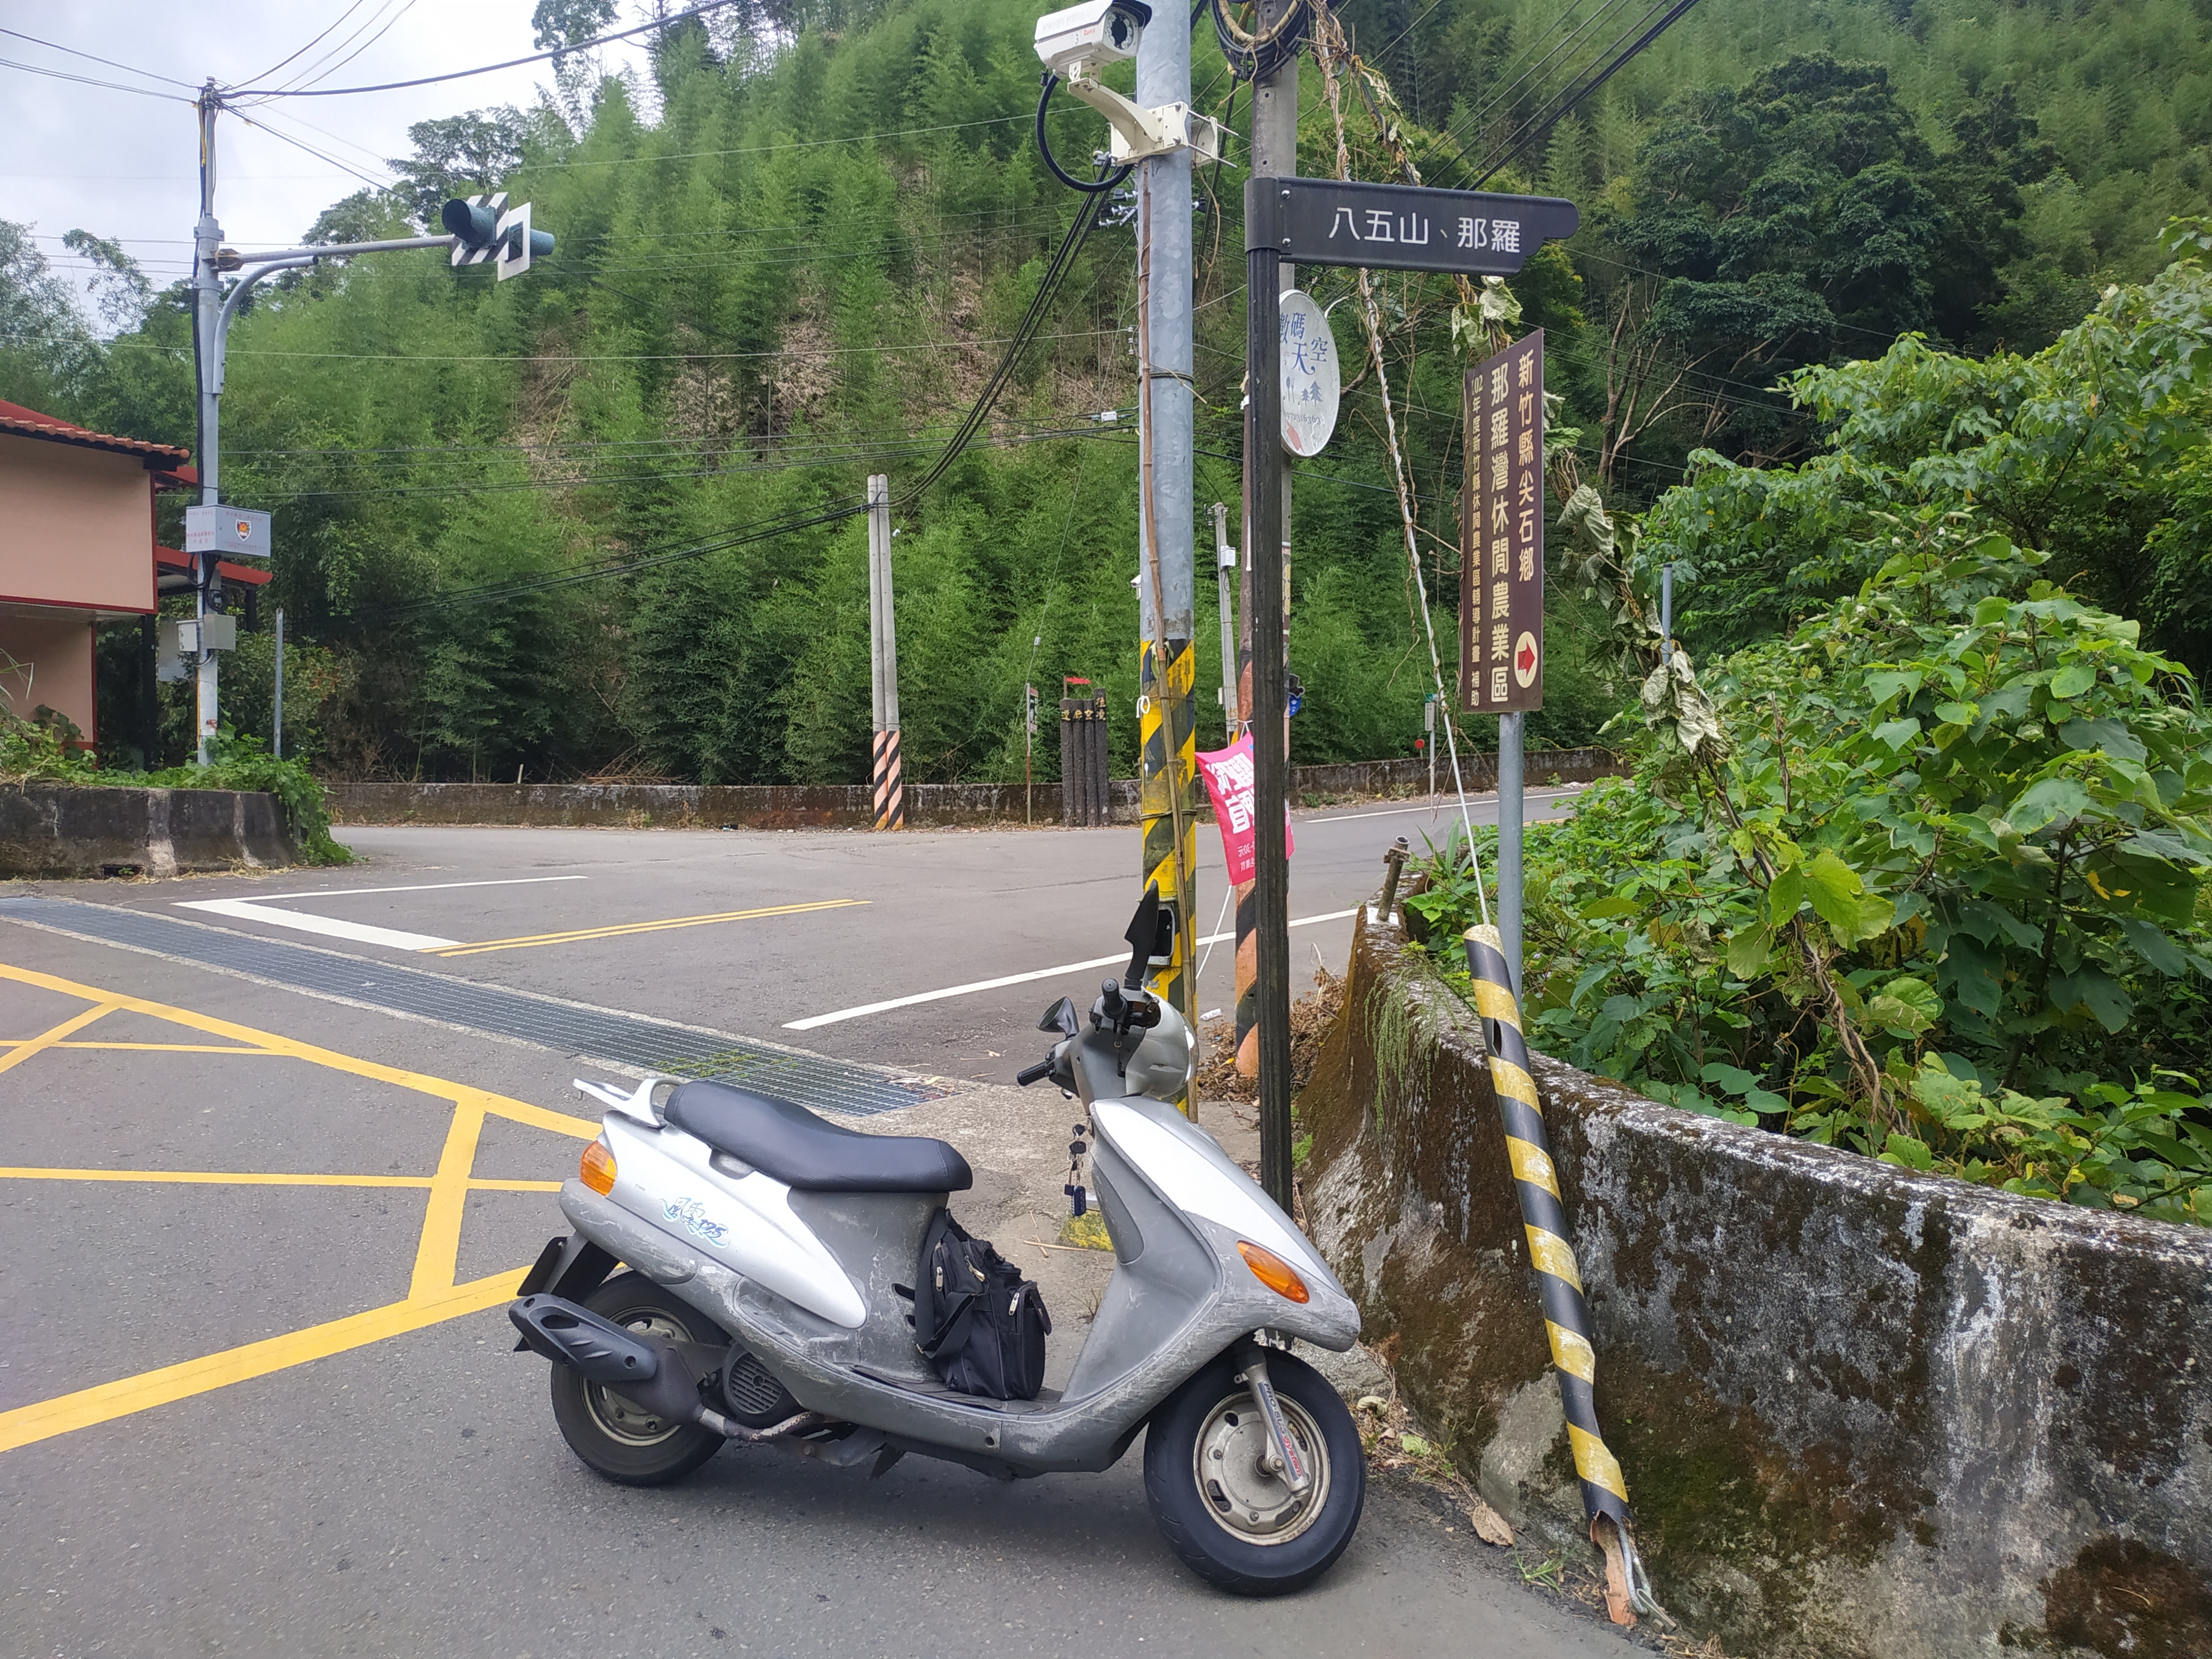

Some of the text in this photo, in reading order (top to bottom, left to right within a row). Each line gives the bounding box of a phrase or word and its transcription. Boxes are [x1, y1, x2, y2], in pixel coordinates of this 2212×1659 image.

[1329, 207, 1520, 253] 八五山、那羅
[1292, 336, 1328, 375] 天空
[1491, 362, 1509, 703] 那羅灣休閒農業區
[1519, 348, 1534, 582] 新竹縣尖石鄉
